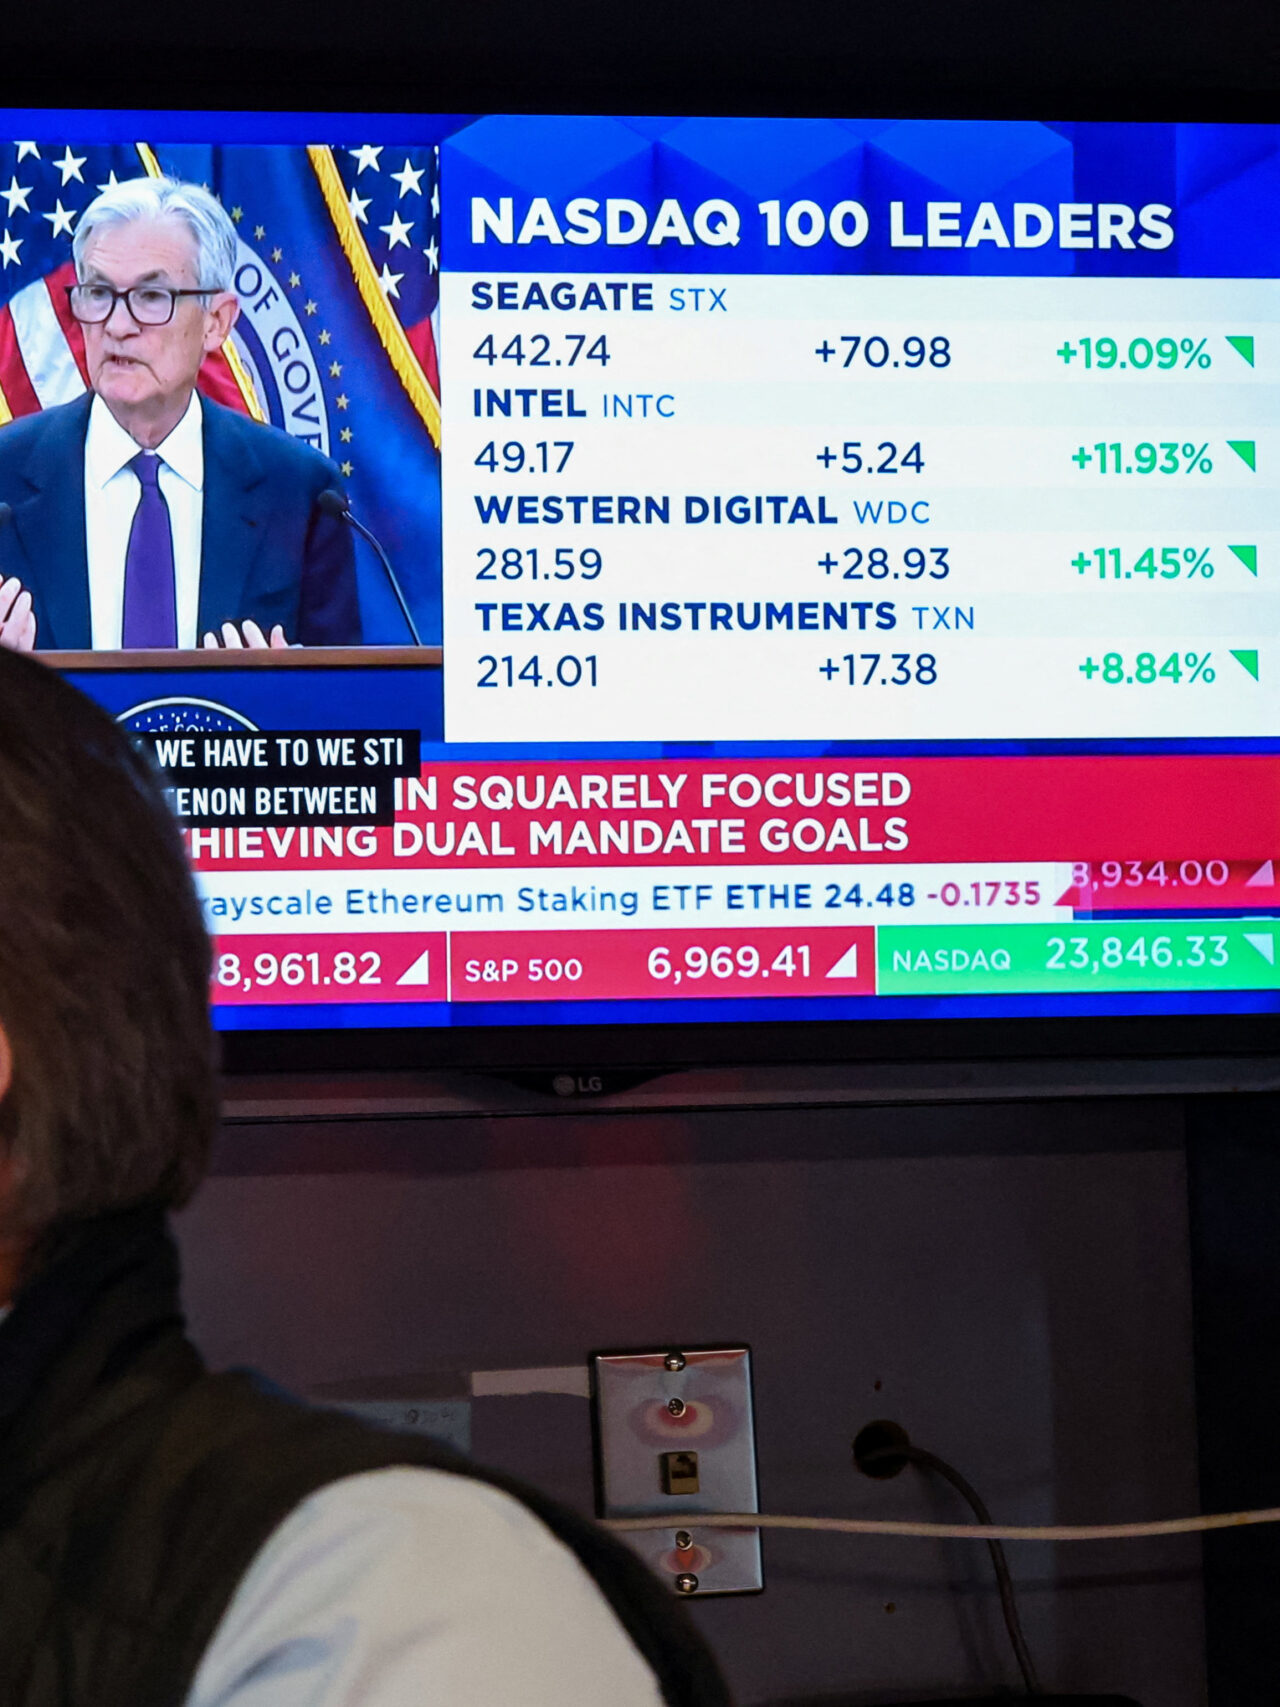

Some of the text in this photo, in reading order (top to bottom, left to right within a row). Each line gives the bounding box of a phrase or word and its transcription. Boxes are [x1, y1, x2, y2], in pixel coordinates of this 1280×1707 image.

[472, 197, 1173, 249] NASDAQ 100 LEADERS
[234, 263, 279, 313] OF
[472, 282, 726, 311] SEAGATE STX
[473, 335, 1211, 369] 442.74 +70.98 +19.09%
[474, 389, 674, 417] INTEL INTC
[475, 441, 1212, 474] 49.17 +5.24 +11.93%
[474, 496, 929, 524] WESTERN DIGITAL WDC
[476, 548, 1214, 579] 281.59 +28.93 +11.45%
[475, 602, 973, 631] TEXAS INSTRUMENTS TXN
[477, 653, 1215, 687] 214.01 +17.38 +8.84%
[156, 738, 402, 767] WE HAVE TO WE STI
[164, 787, 376, 815] ENON BETWEEN
[453, 774, 687, 810] SQUARELY
[703, 773, 910, 807] FOCUSED
[181, 817, 908, 858] HIEVING DUAL MANDATE GOALS
[347, 889, 503, 914] Ethereum
[518, 887, 637, 916] Staking
[653, 885, 712, 910] ETF
[727, 884, 811, 909] ETHE
[825, 883, 914, 908] 24.48
[928, 882, 1040, 906] -0.1735
[210, 951, 381, 992] 8,961.82
[466, 946, 809, 984] S&P 500 6,969.41
[893, 936, 1228, 974] NASDAQ 23,846.33
[578, 1077, 602, 1092] LG
